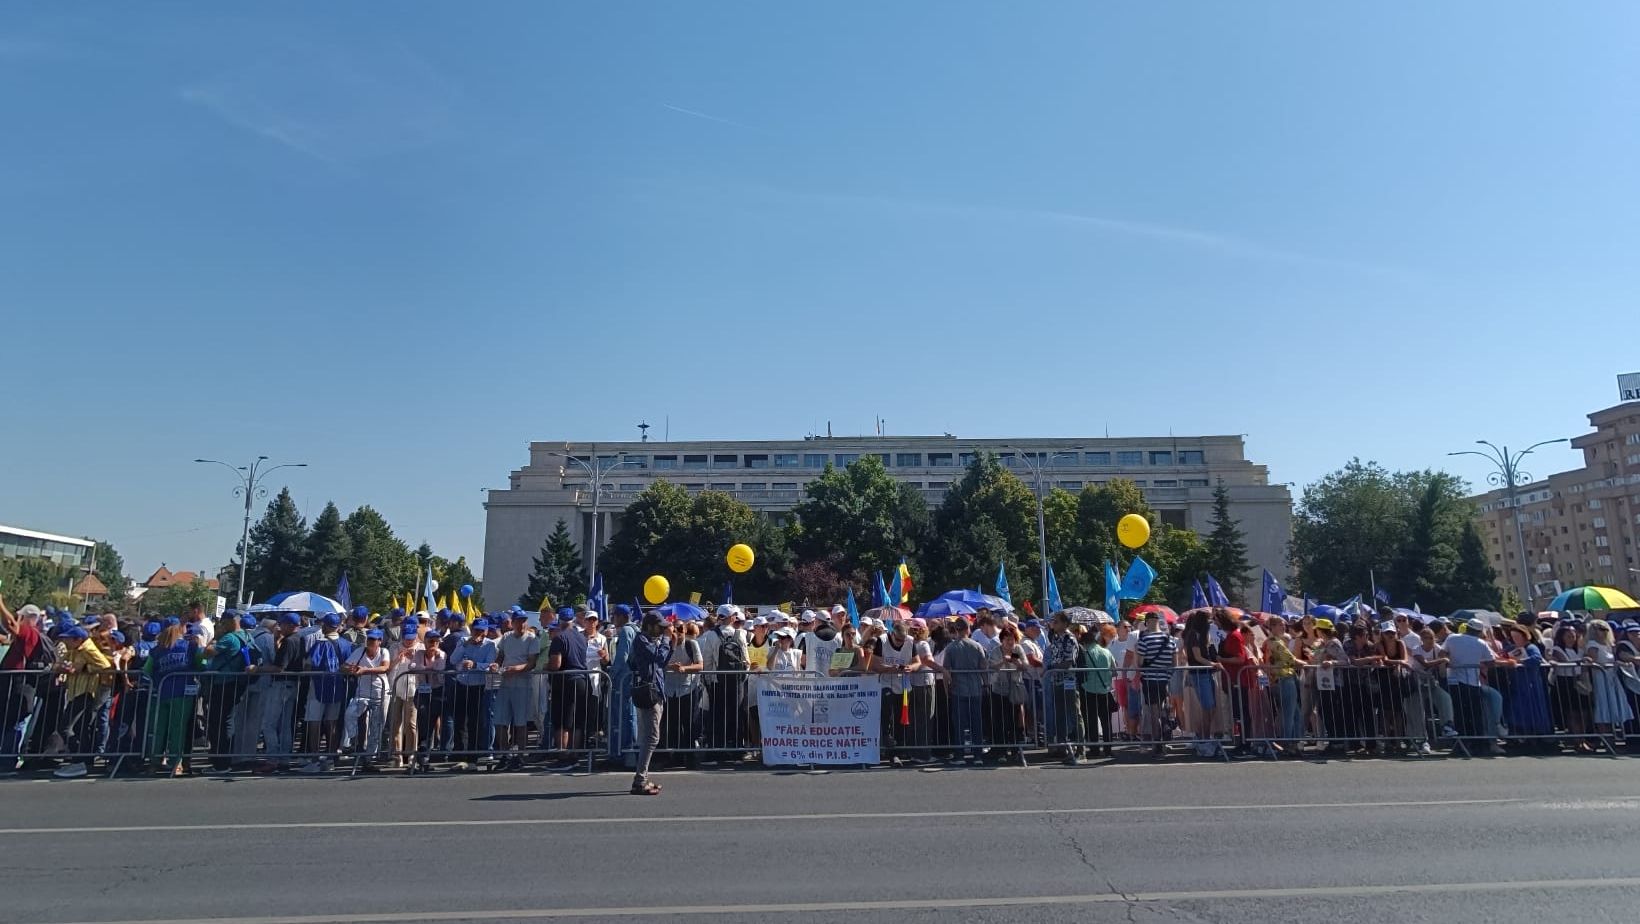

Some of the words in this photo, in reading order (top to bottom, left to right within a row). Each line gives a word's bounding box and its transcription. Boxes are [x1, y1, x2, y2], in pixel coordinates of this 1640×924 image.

[763, 738, 798, 747] MOARE
[802, 738, 833, 748] ORICE
[790, 751, 806, 760] 6%
[808, 751, 824, 760] din
[826, 751, 850, 760] P.I.B.
